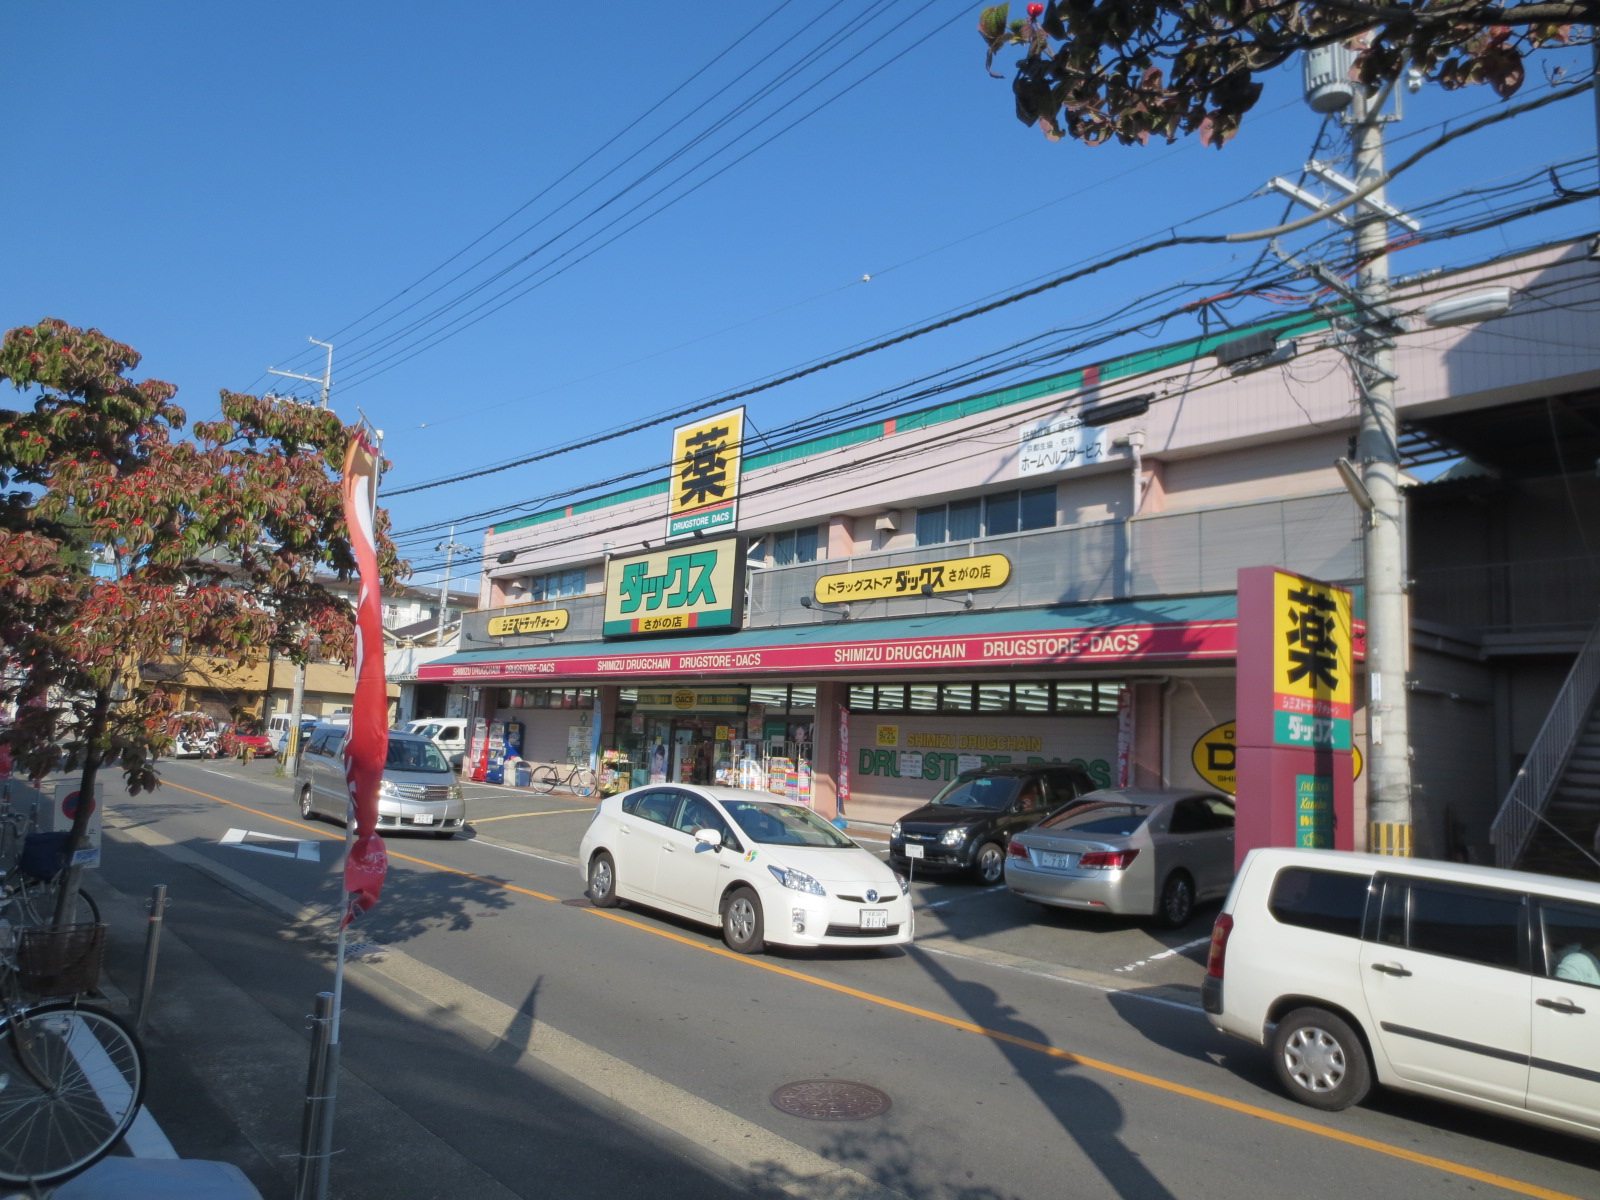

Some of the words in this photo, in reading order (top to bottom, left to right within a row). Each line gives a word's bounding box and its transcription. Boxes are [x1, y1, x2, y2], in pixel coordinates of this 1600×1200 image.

[680, 426, 729, 507] 薬
[1022, 442, 1103, 471] ホームヘルプサービス
[673, 516, 709, 531] DRUGSTORE
[711, 511, 730, 523] DACS
[620, 549, 718, 614] ダックス
[827, 576, 893, 595] ドラッグストア
[895, 566, 945, 592] ダックス
[948, 565, 991, 582] さがの店
[644, 616, 682, 630] さがの店
[834, 647, 882, 663] SHIMIZU
[885, 643, 966, 661] DRUGCHAIN
[983, 633, 1140, 658] DRUGSTORE-DACS
[1285, 587, 1339, 691] 薬
[453, 667, 471, 676] SHIMIZU
[597, 659, 625, 671] SHIMIZU
[626, 657, 671, 670] DRUGCHAIN
[680, 653, 761, 669] DRUGSTORE-DACS
[907, 733, 956, 749] SHIMIZU
[958, 735, 1043, 751] DRUGCHAIN
[1288, 715, 1335, 744] ダックス
